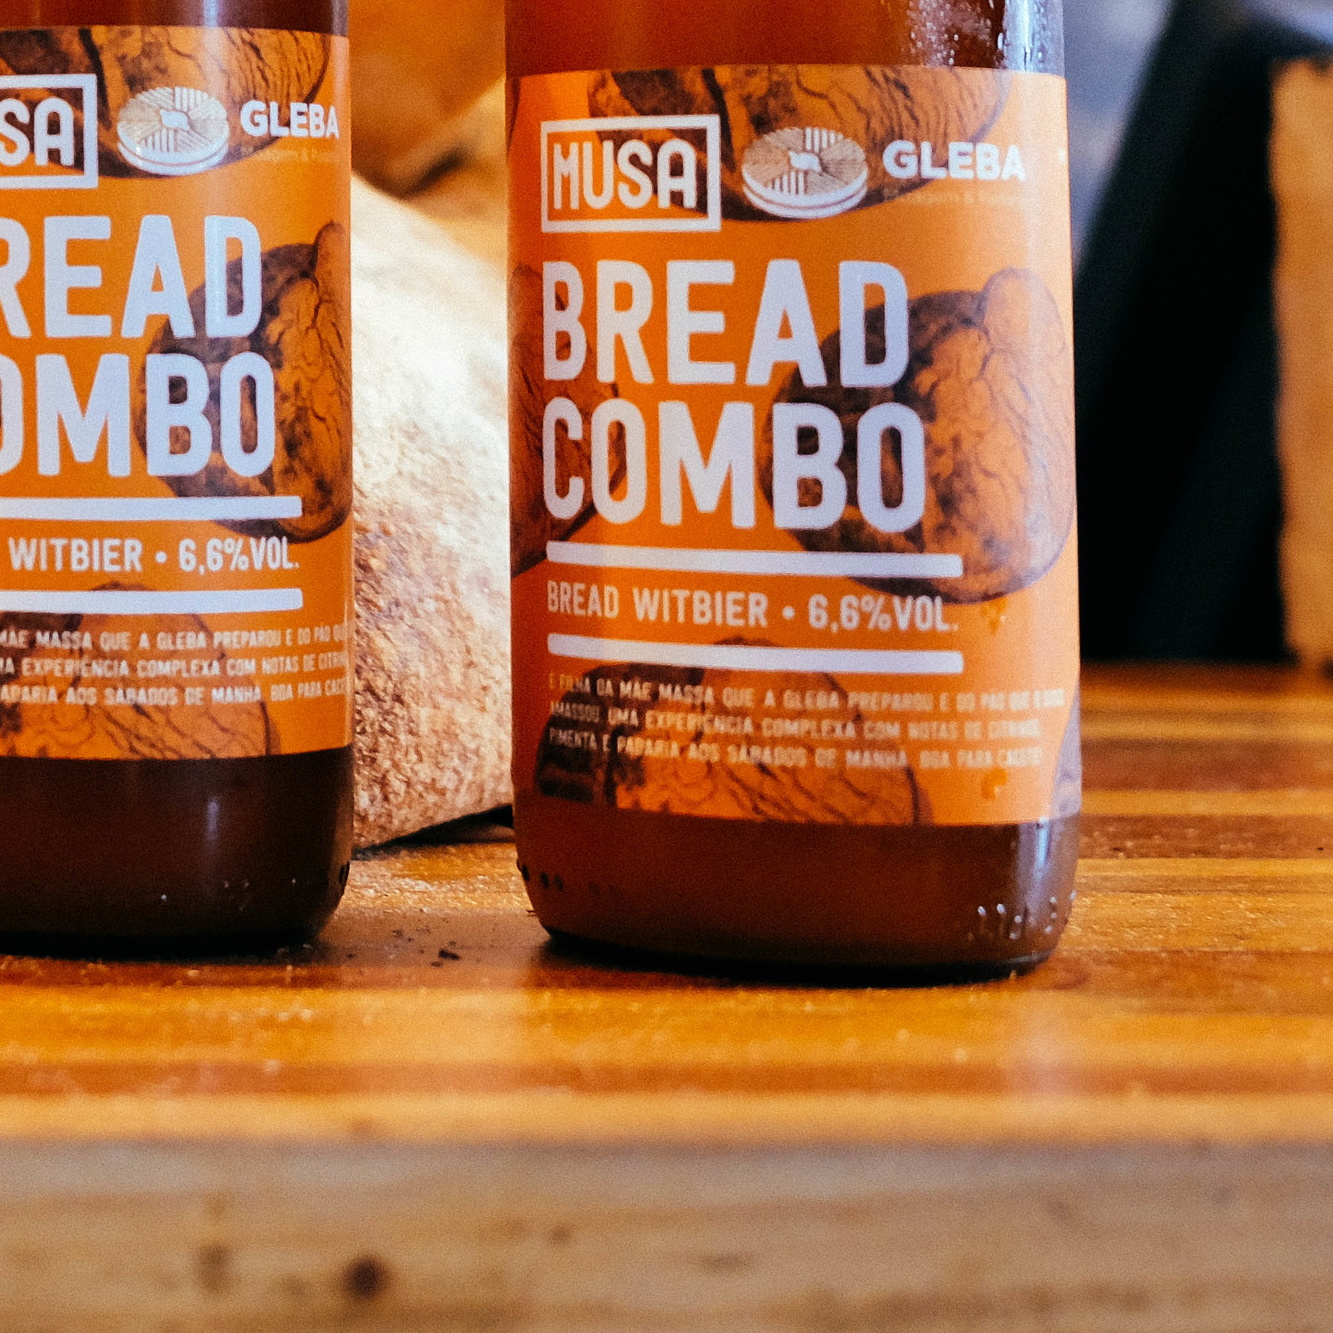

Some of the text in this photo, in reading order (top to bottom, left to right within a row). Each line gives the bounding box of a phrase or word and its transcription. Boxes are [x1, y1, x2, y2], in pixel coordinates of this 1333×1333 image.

[240, 99, 340, 140] GLEBA
[552, 138, 697, 211] MUSA
[883, 139, 1026, 182] GLEBA
[542, 258, 910, 388] BREAD
[542, 395, 926, 534] COMBO
[9, 537, 143, 573] WITBIER
[547, 580, 620, 619] BREAD
[633, 586, 769, 628] WITBIER
[36, 629, 92, 650] MASSA
[99, 631, 132, 652] QUE
[139, 632, 151, 651] A
[156, 631, 207, 651] GLEBA
[285, 628, 293, 646] E
[137, 658, 221, 678] COMPLEXA
[226, 658, 256, 676] COM
[261, 655, 299, 675] NOTAS
[66, 686, 97, 706] AOS
[185, 686, 206, 706] DE
[764, 688, 776, 707] A
[608, 706, 639, 727] UMA
